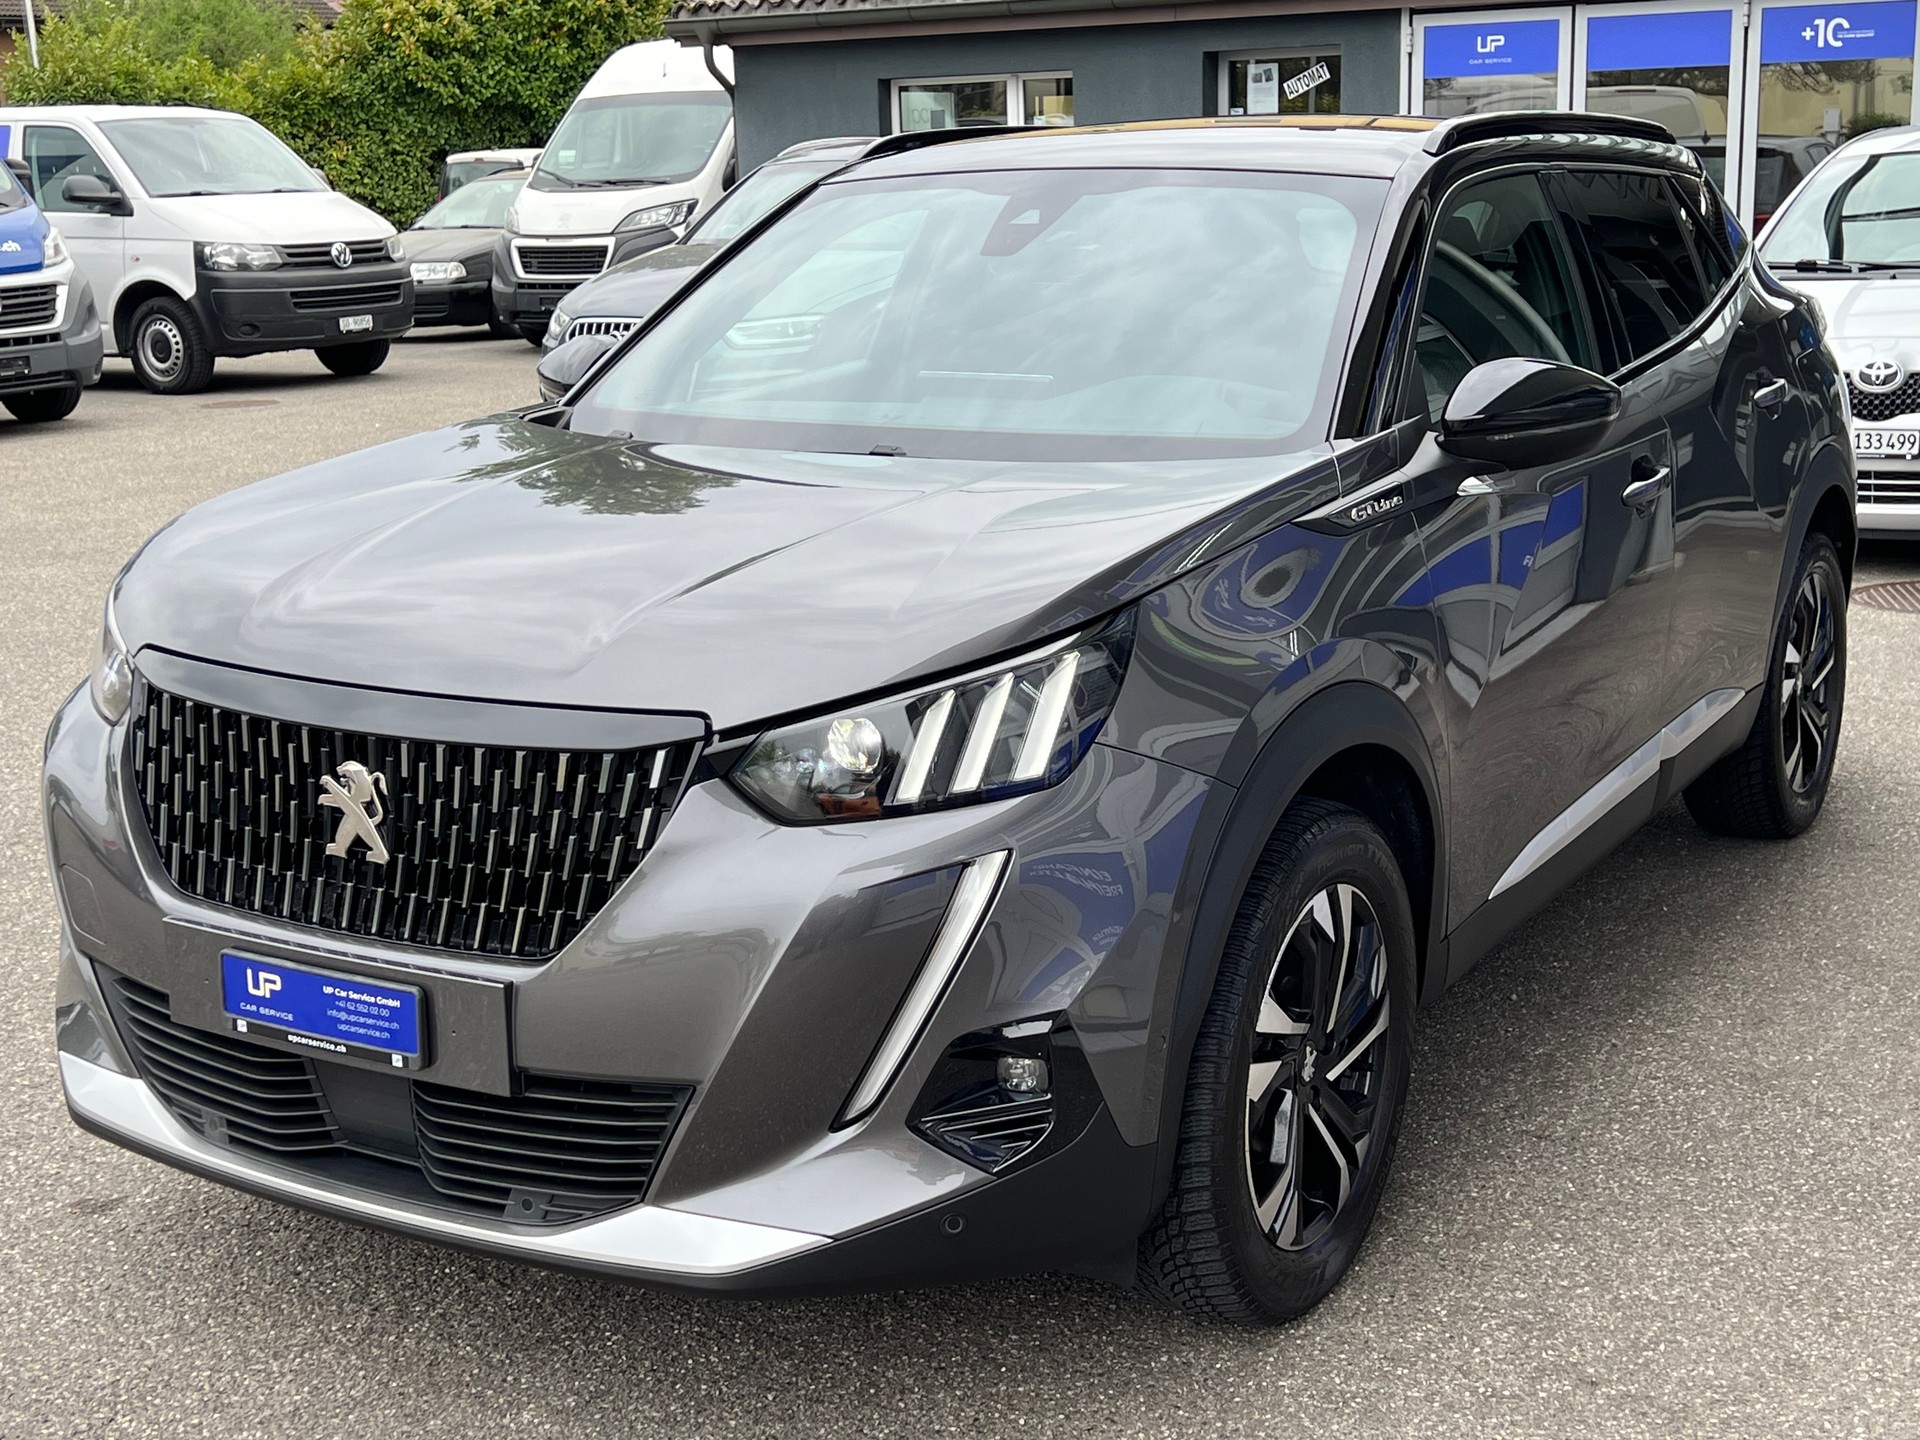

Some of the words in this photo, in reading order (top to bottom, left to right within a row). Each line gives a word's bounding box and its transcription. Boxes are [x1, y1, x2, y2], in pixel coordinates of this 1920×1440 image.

[1477, 34, 1505, 53] UP
[1286, 63, 1328, 97] AUTOMAT
[246, 966, 282, 998] UP
[322, 985, 334, 994] UP
[335, 988, 348, 998] Car
[348, 990, 375, 1003] Service
[376, 996, 401, 1008] GmbH
[240, 1002, 257, 1012] CAR
[259, 1006, 294, 1021] SERVICE
[346, 1001, 356, 1010] 62
[356, 1003, 368, 1013] 552
[369, 1006, 379, 1015] 02
[379, 1008, 390, 1017] 00
[326, 1008, 400, 1030] info@upcarservice.ch
[337, 1023, 391, 1039] upcarservice.ch
[287, 1034, 347, 1053] upcarservice.ch
